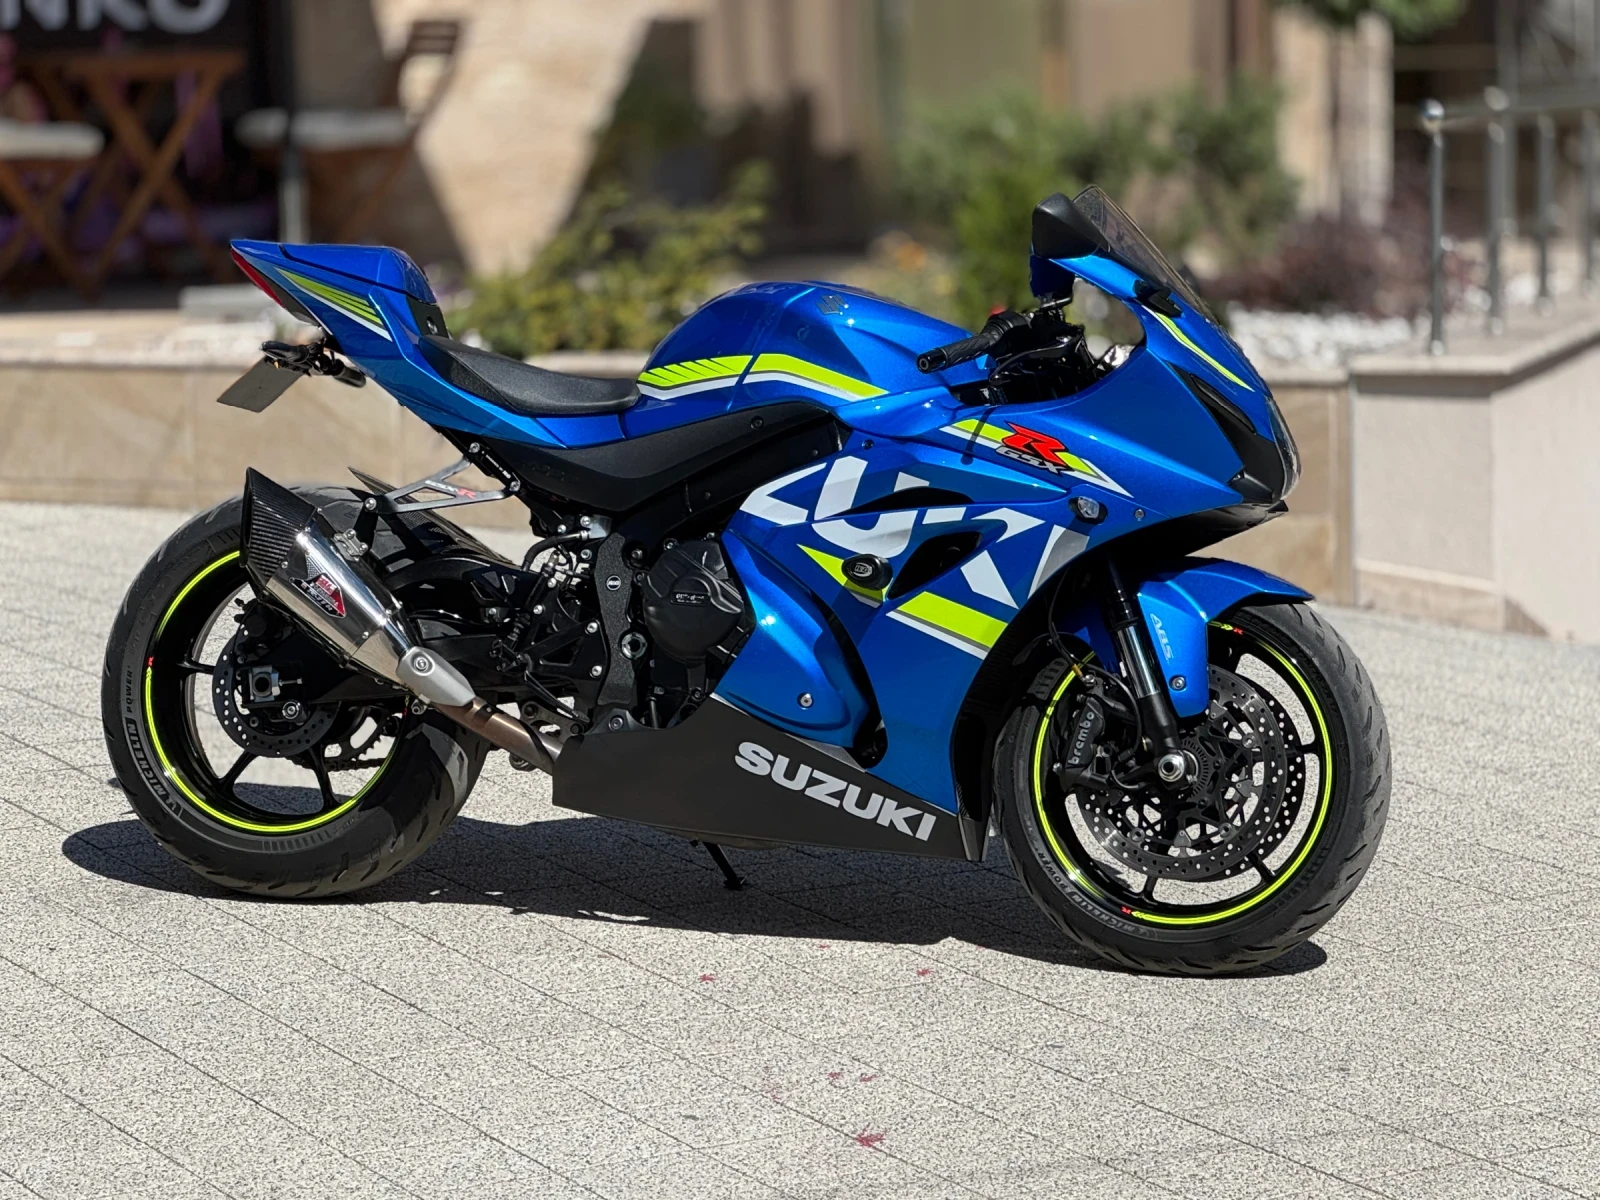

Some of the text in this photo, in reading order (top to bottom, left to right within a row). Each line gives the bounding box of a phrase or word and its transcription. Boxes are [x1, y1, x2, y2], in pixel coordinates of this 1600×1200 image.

[125, 669, 167, 797] MICHELIN POWER
[1067, 711, 1095, 765] brembo
[734, 741, 937, 842] SUZUKI
[1037, 852, 1135, 933] MICHELIN POWER
